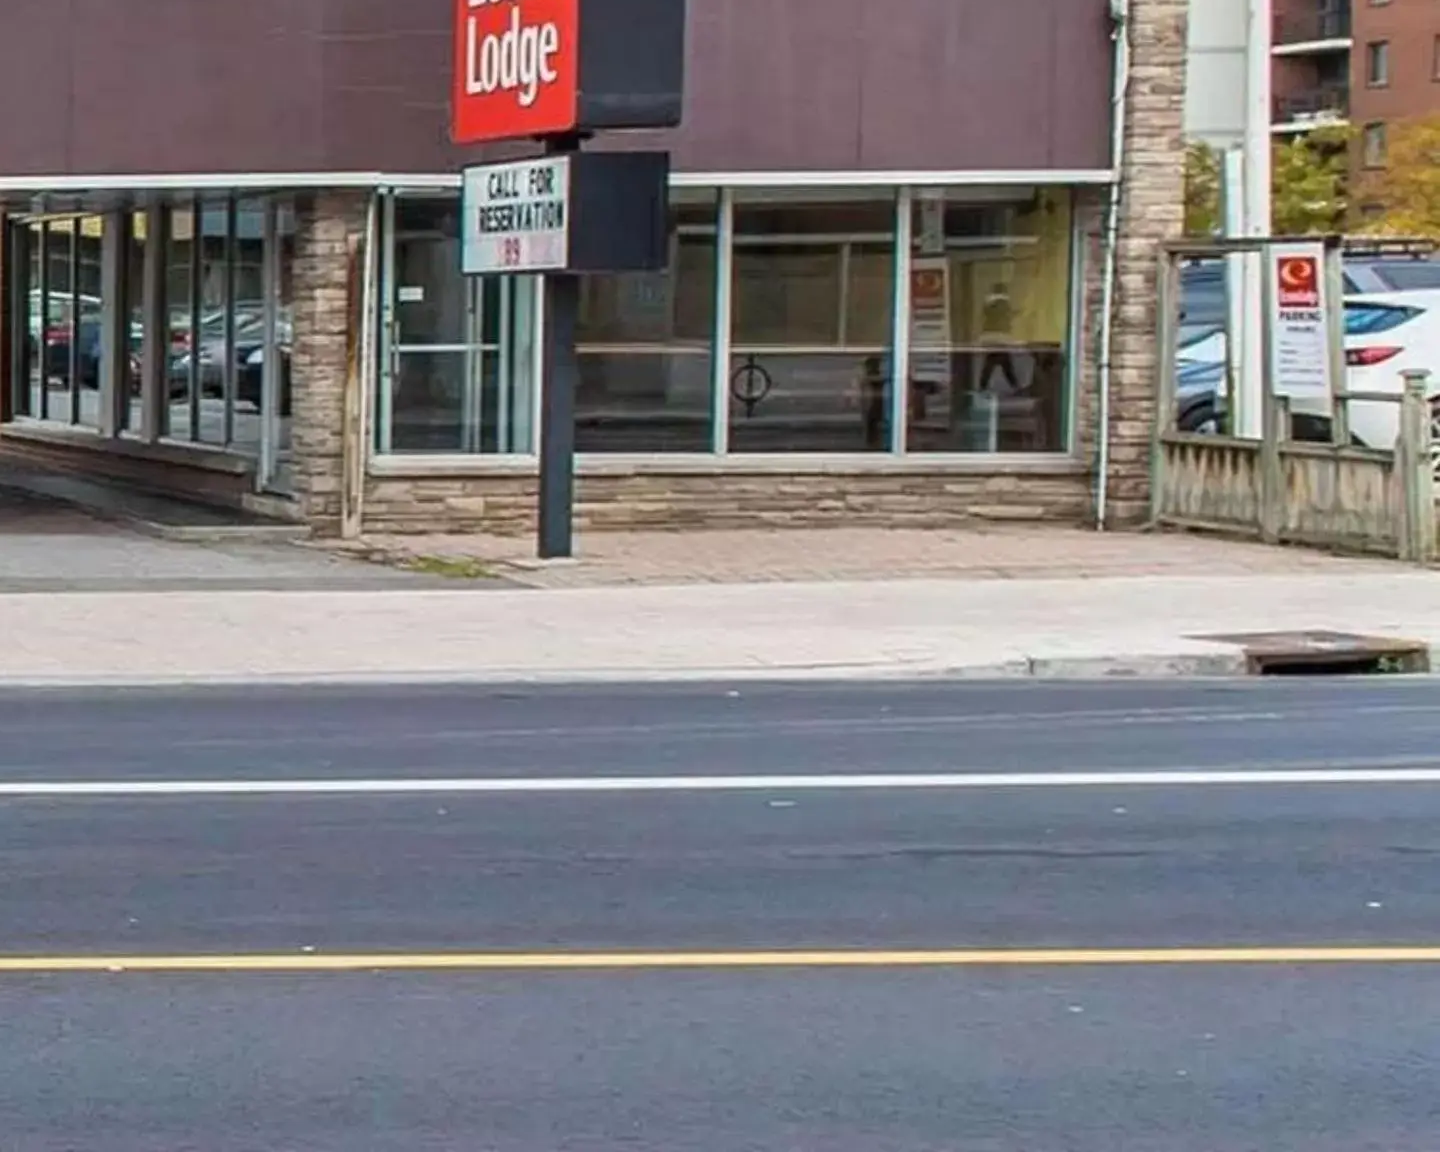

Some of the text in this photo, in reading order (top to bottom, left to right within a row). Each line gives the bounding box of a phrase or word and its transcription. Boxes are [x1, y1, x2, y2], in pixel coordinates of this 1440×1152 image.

[467, 5, 559, 107] Lodge
[487, 166, 554, 201] CALL FOR
[479, 200, 564, 234] RESERVATION
